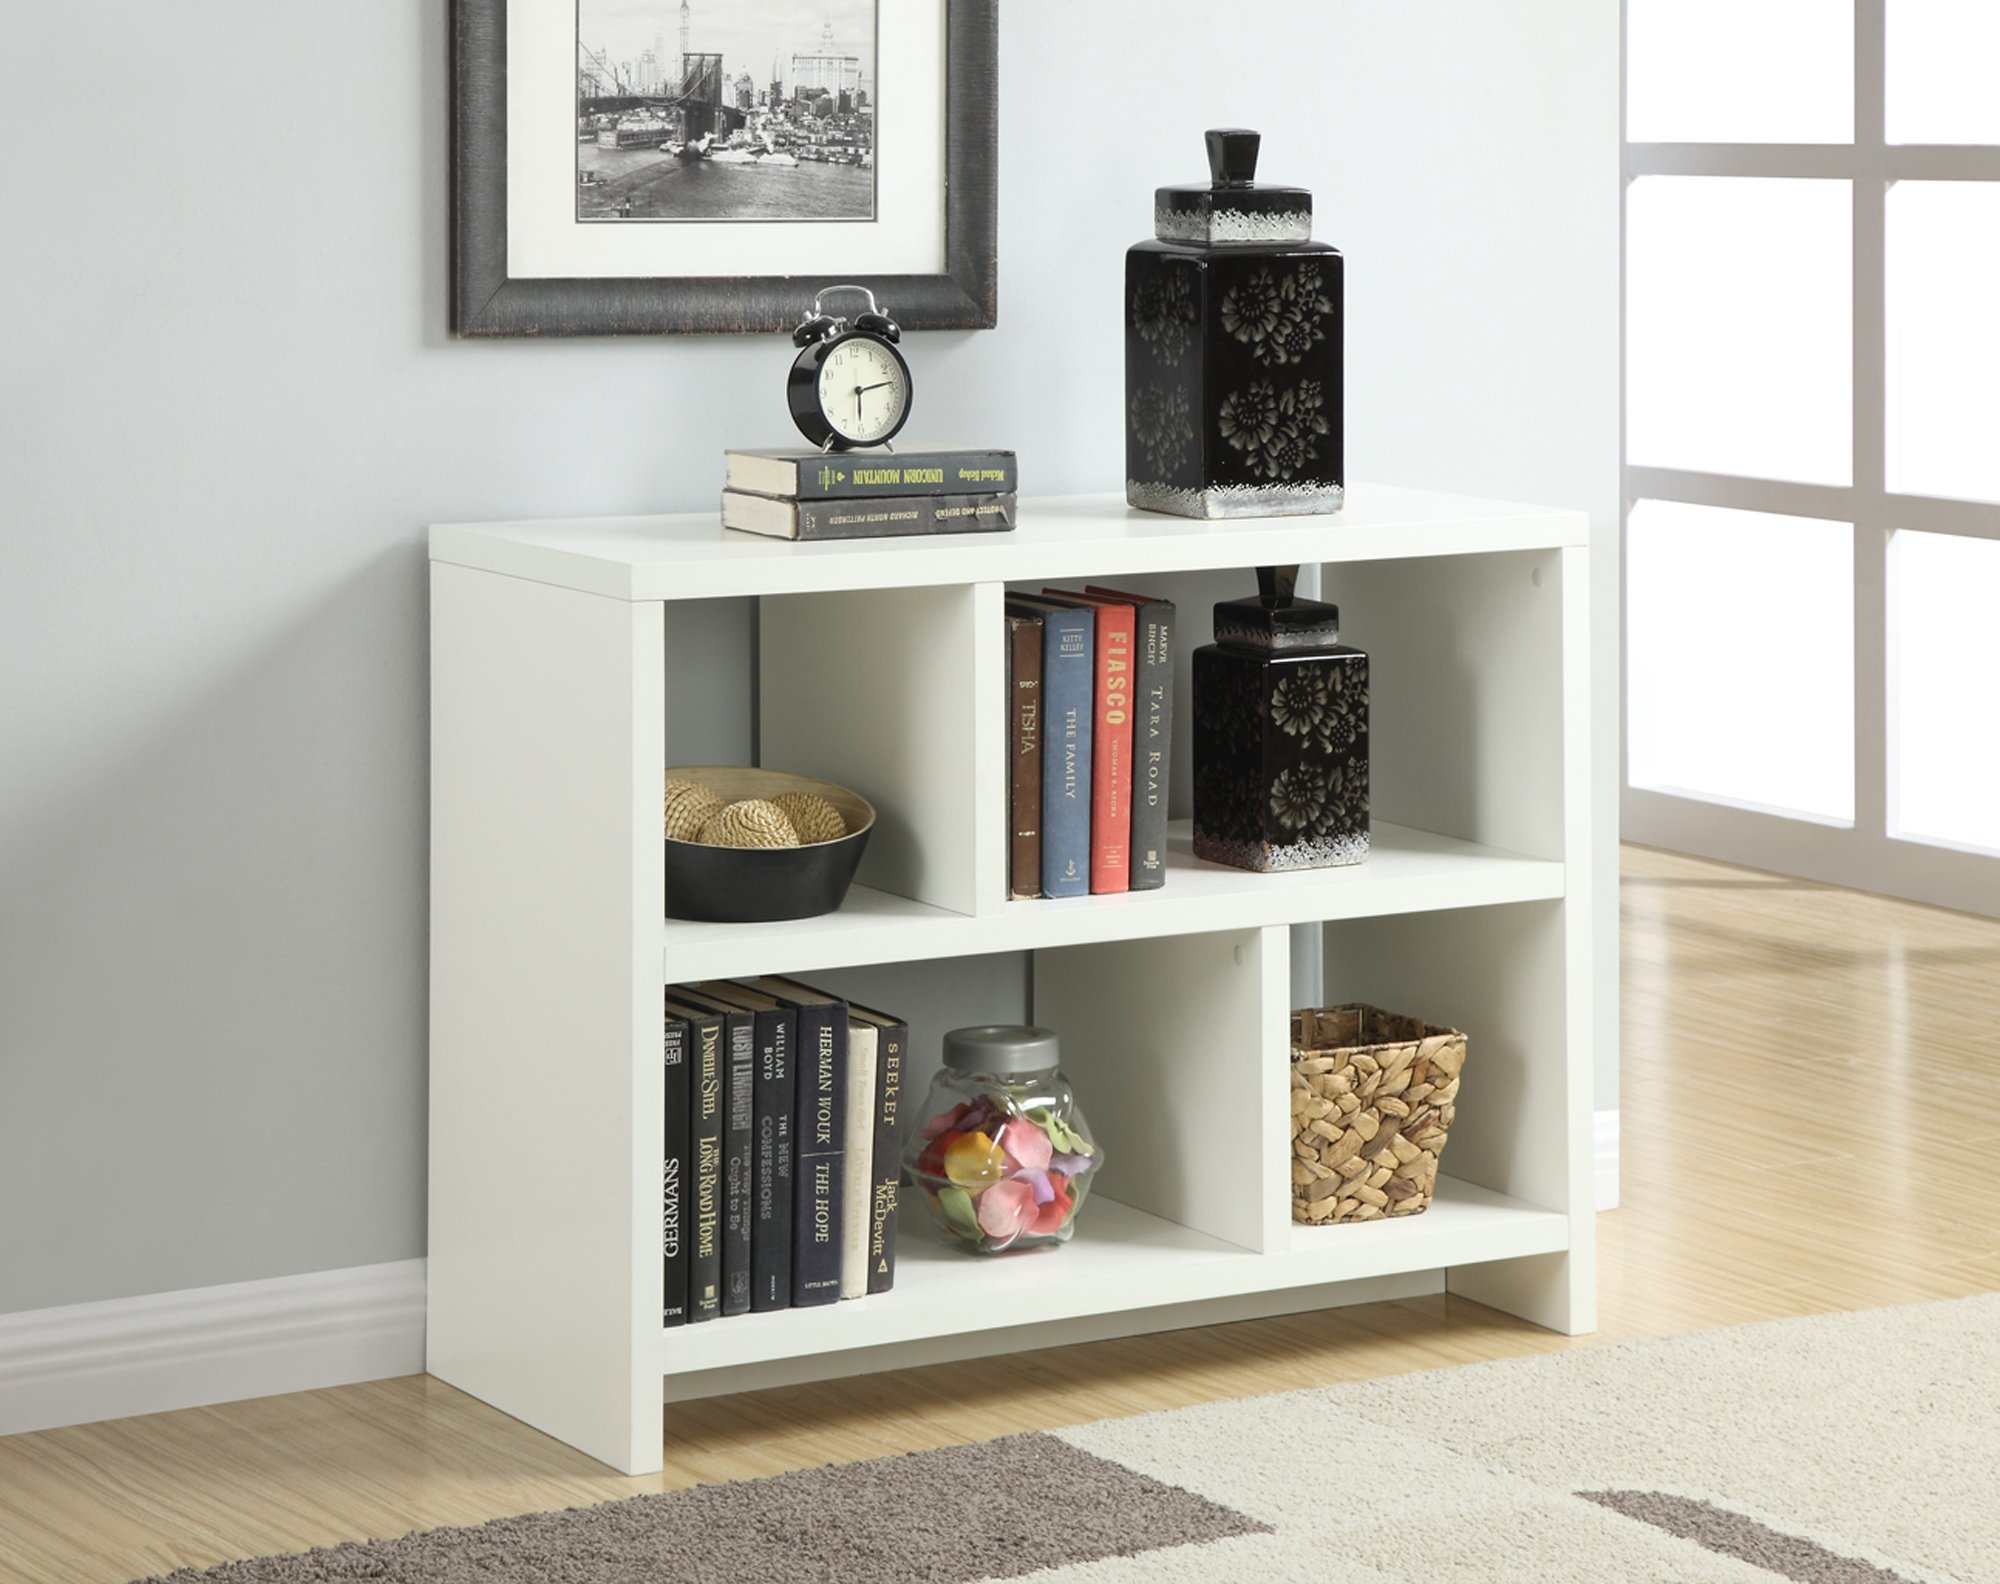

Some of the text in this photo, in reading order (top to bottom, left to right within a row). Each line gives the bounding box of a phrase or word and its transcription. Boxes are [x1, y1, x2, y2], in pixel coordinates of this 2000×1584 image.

[852, 469, 900, 485] MOUNTAIN
[904, 469, 944, 484] UNICORN
[959, 468, 1005, 482] Michael Bishop
[829, 511, 918, 525] RICHARD NORTH PATTERSON
[1060, 643, 1084, 651] KELLEY
[1147, 623, 1158, 666] BINCHY
[1158, 625, 1168, 664] MAEVE
[1105, 631, 1128, 725] FIASCO
[1020, 700, 1037, 755] TISHA
[1065, 707, 1077, 799] THE FAMILY
[1148, 686, 1163, 806] TARA ROAD
[1111, 739, 1119, 777] THOMAS
[701, 1025, 720, 1120] DANIELLE STEEL
[763, 1047, 774, 1080] BOYD
[776, 1022, 786, 1079] WILLIAM
[816, 1025, 832, 1144] HERMAN WOUK
[760, 1116, 774, 1220] CONFESSIONS
[778, 1114, 790, 1178] THE NEW
[664, 1158, 680, 1257] GERMANS
[698, 1135, 717, 1258] LONG ROAD HOME
[728, 1157, 741, 1231] Ought to Be
[815, 1163, 829, 1243] THE HOPE
[873, 1183, 887, 1256] McDevitt
[885, 1178, 899, 1212] Jack
